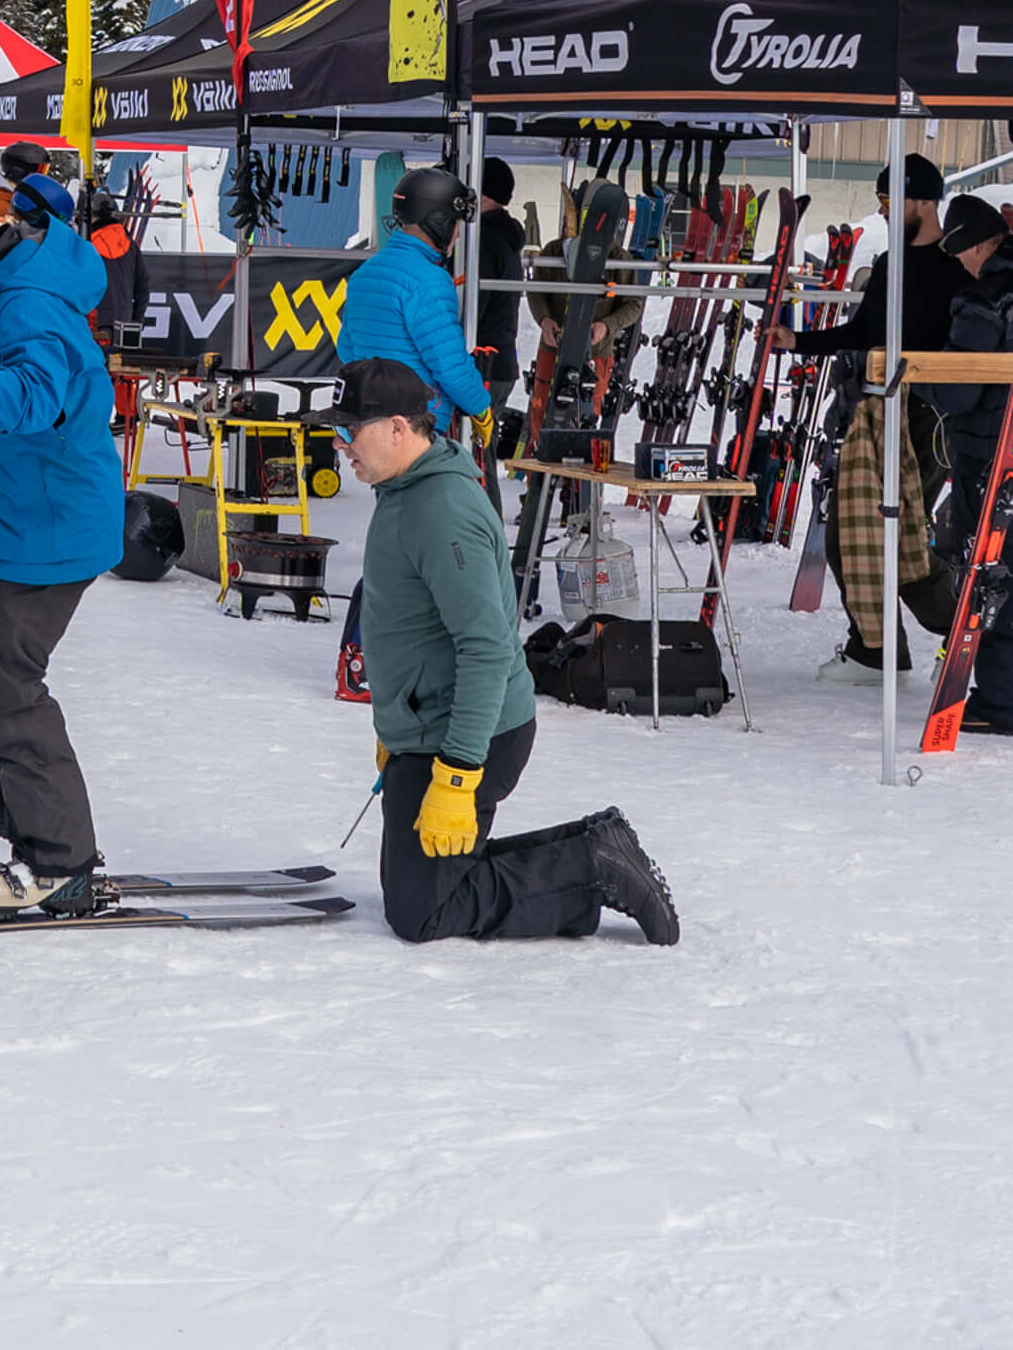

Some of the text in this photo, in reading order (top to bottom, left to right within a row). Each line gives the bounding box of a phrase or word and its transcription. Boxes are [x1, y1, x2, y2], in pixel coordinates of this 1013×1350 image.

[488, 30, 629, 77] HEAD
[248, 66, 294, 93] ROSSIGNOL
[110, 88, 149, 120] Völkl
